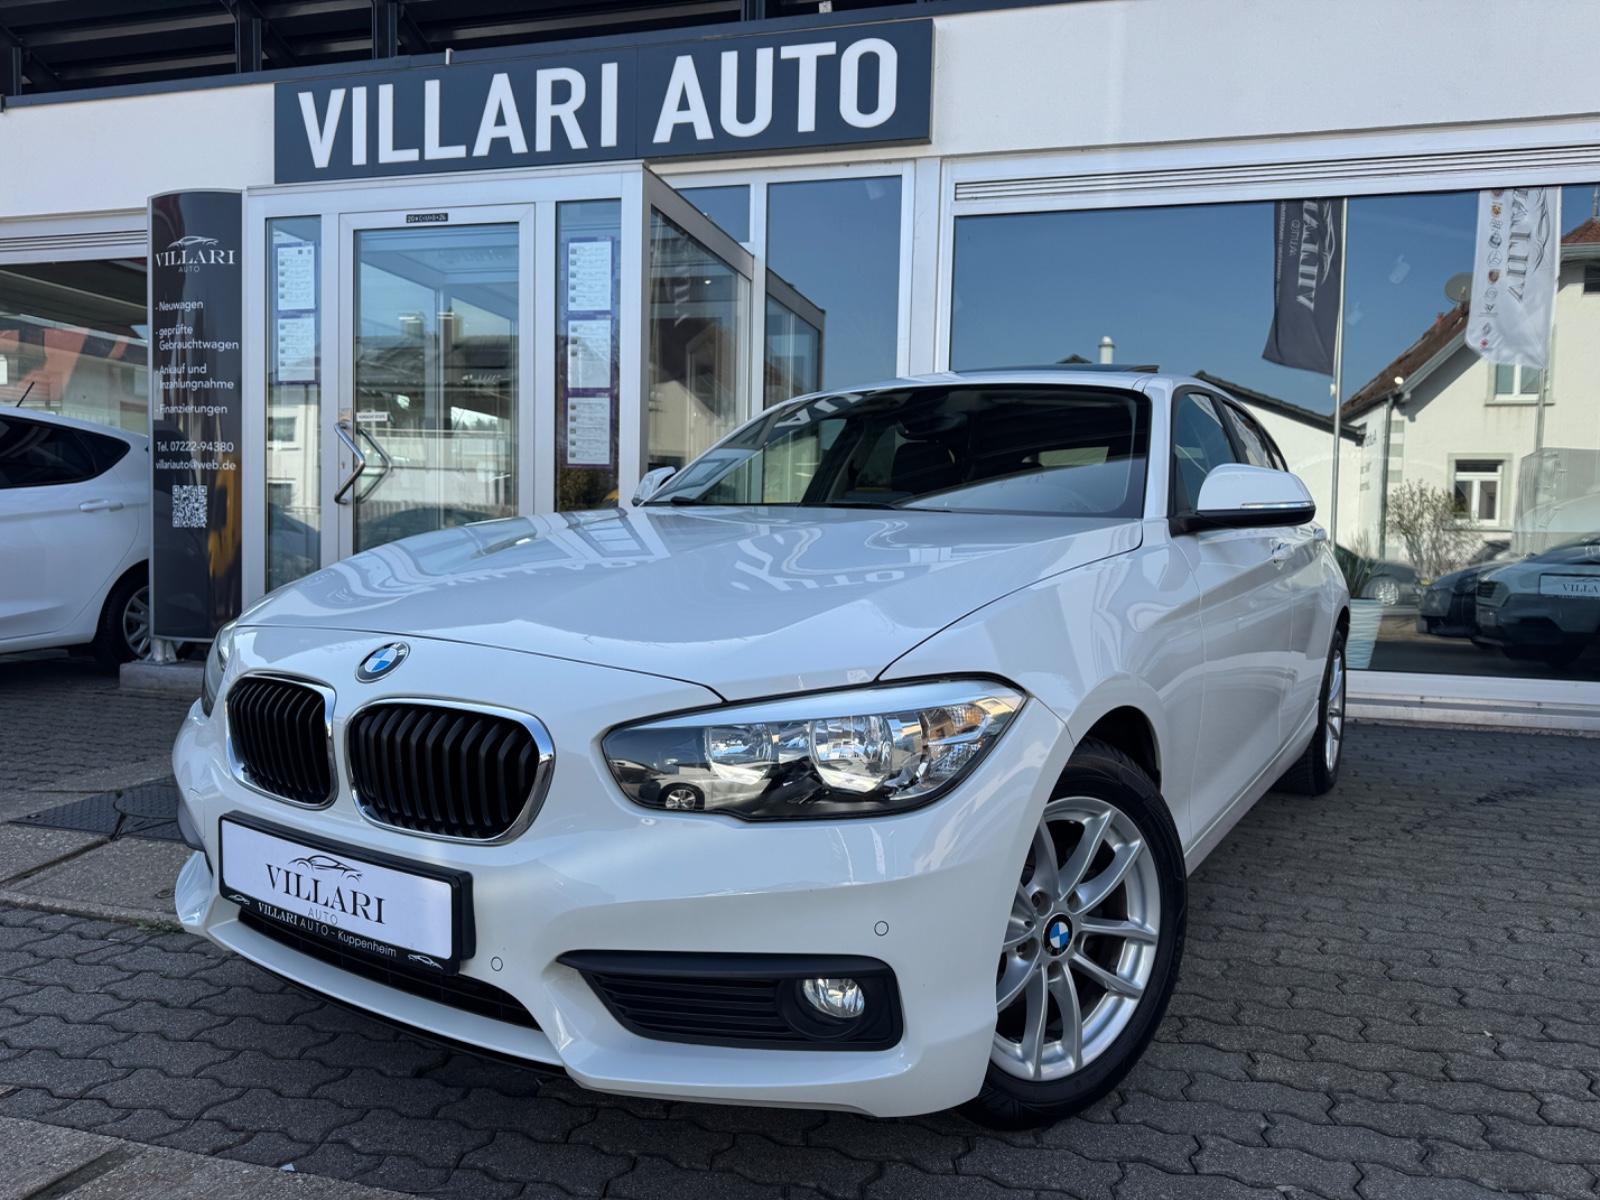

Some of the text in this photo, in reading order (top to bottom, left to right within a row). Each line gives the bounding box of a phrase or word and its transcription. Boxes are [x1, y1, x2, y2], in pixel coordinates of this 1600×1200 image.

[297, 37, 898, 169] VILLARI AUTO
[156, 250, 236, 267] VILLARI
[178, 265, 200, 273] AUTO
[159, 301, 204, 312] Neuwagen
[159, 324, 193, 338] geprüfte
[159, 338, 239, 352] Gebrauchtwagen
[160, 363, 207, 375] Ankauf und
[157, 441, 234, 452] Tel. 07222-94380
[156, 459, 237, 471] villariauto@web.de
[266, 863, 387, 925] VILLARI
[308, 906, 338, 926] AUTO
[258, 902, 298, 926] VILLARI
[299, 918, 329, 936] AUTO
[338, 930, 397, 957] Kuppenheim
